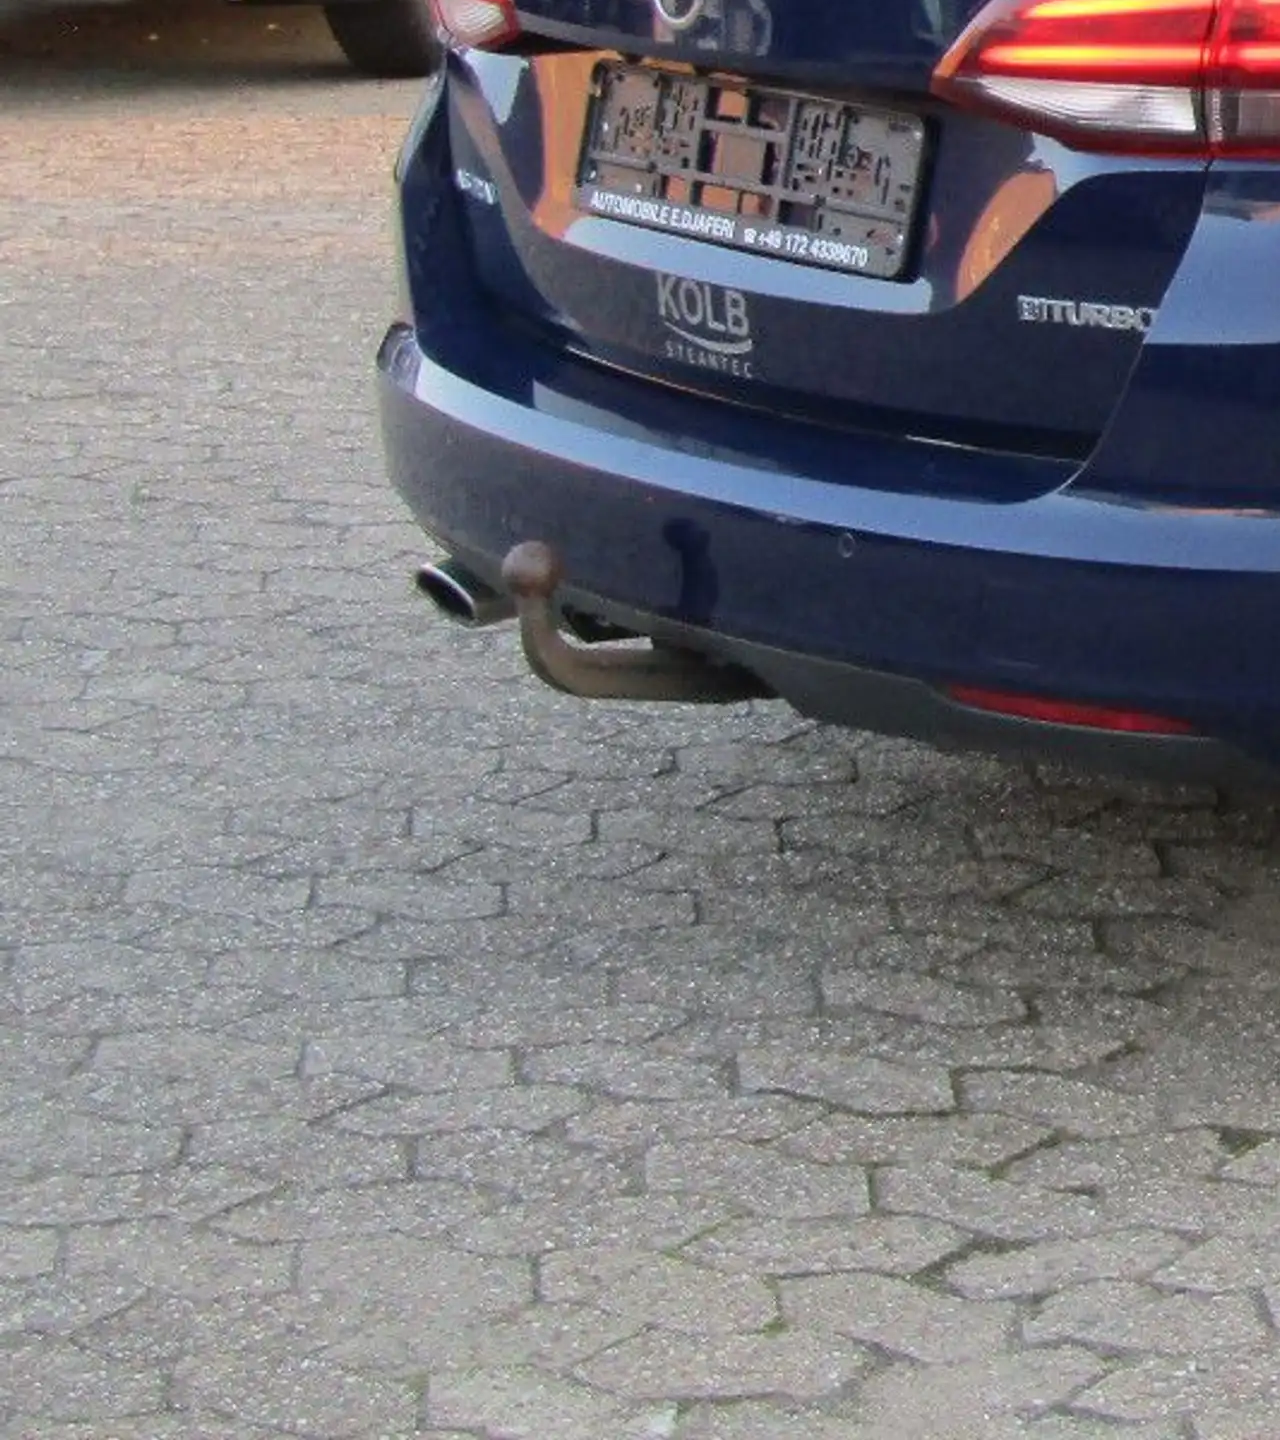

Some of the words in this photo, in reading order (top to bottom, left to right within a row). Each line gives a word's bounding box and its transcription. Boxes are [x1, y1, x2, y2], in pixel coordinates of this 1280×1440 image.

[590, 191, 669, 225] AUTOMOBILE
[785, 233, 808, 256] 172
[656, 270, 749, 336] KOLB
[1017, 295, 1158, 332] BITURBO
